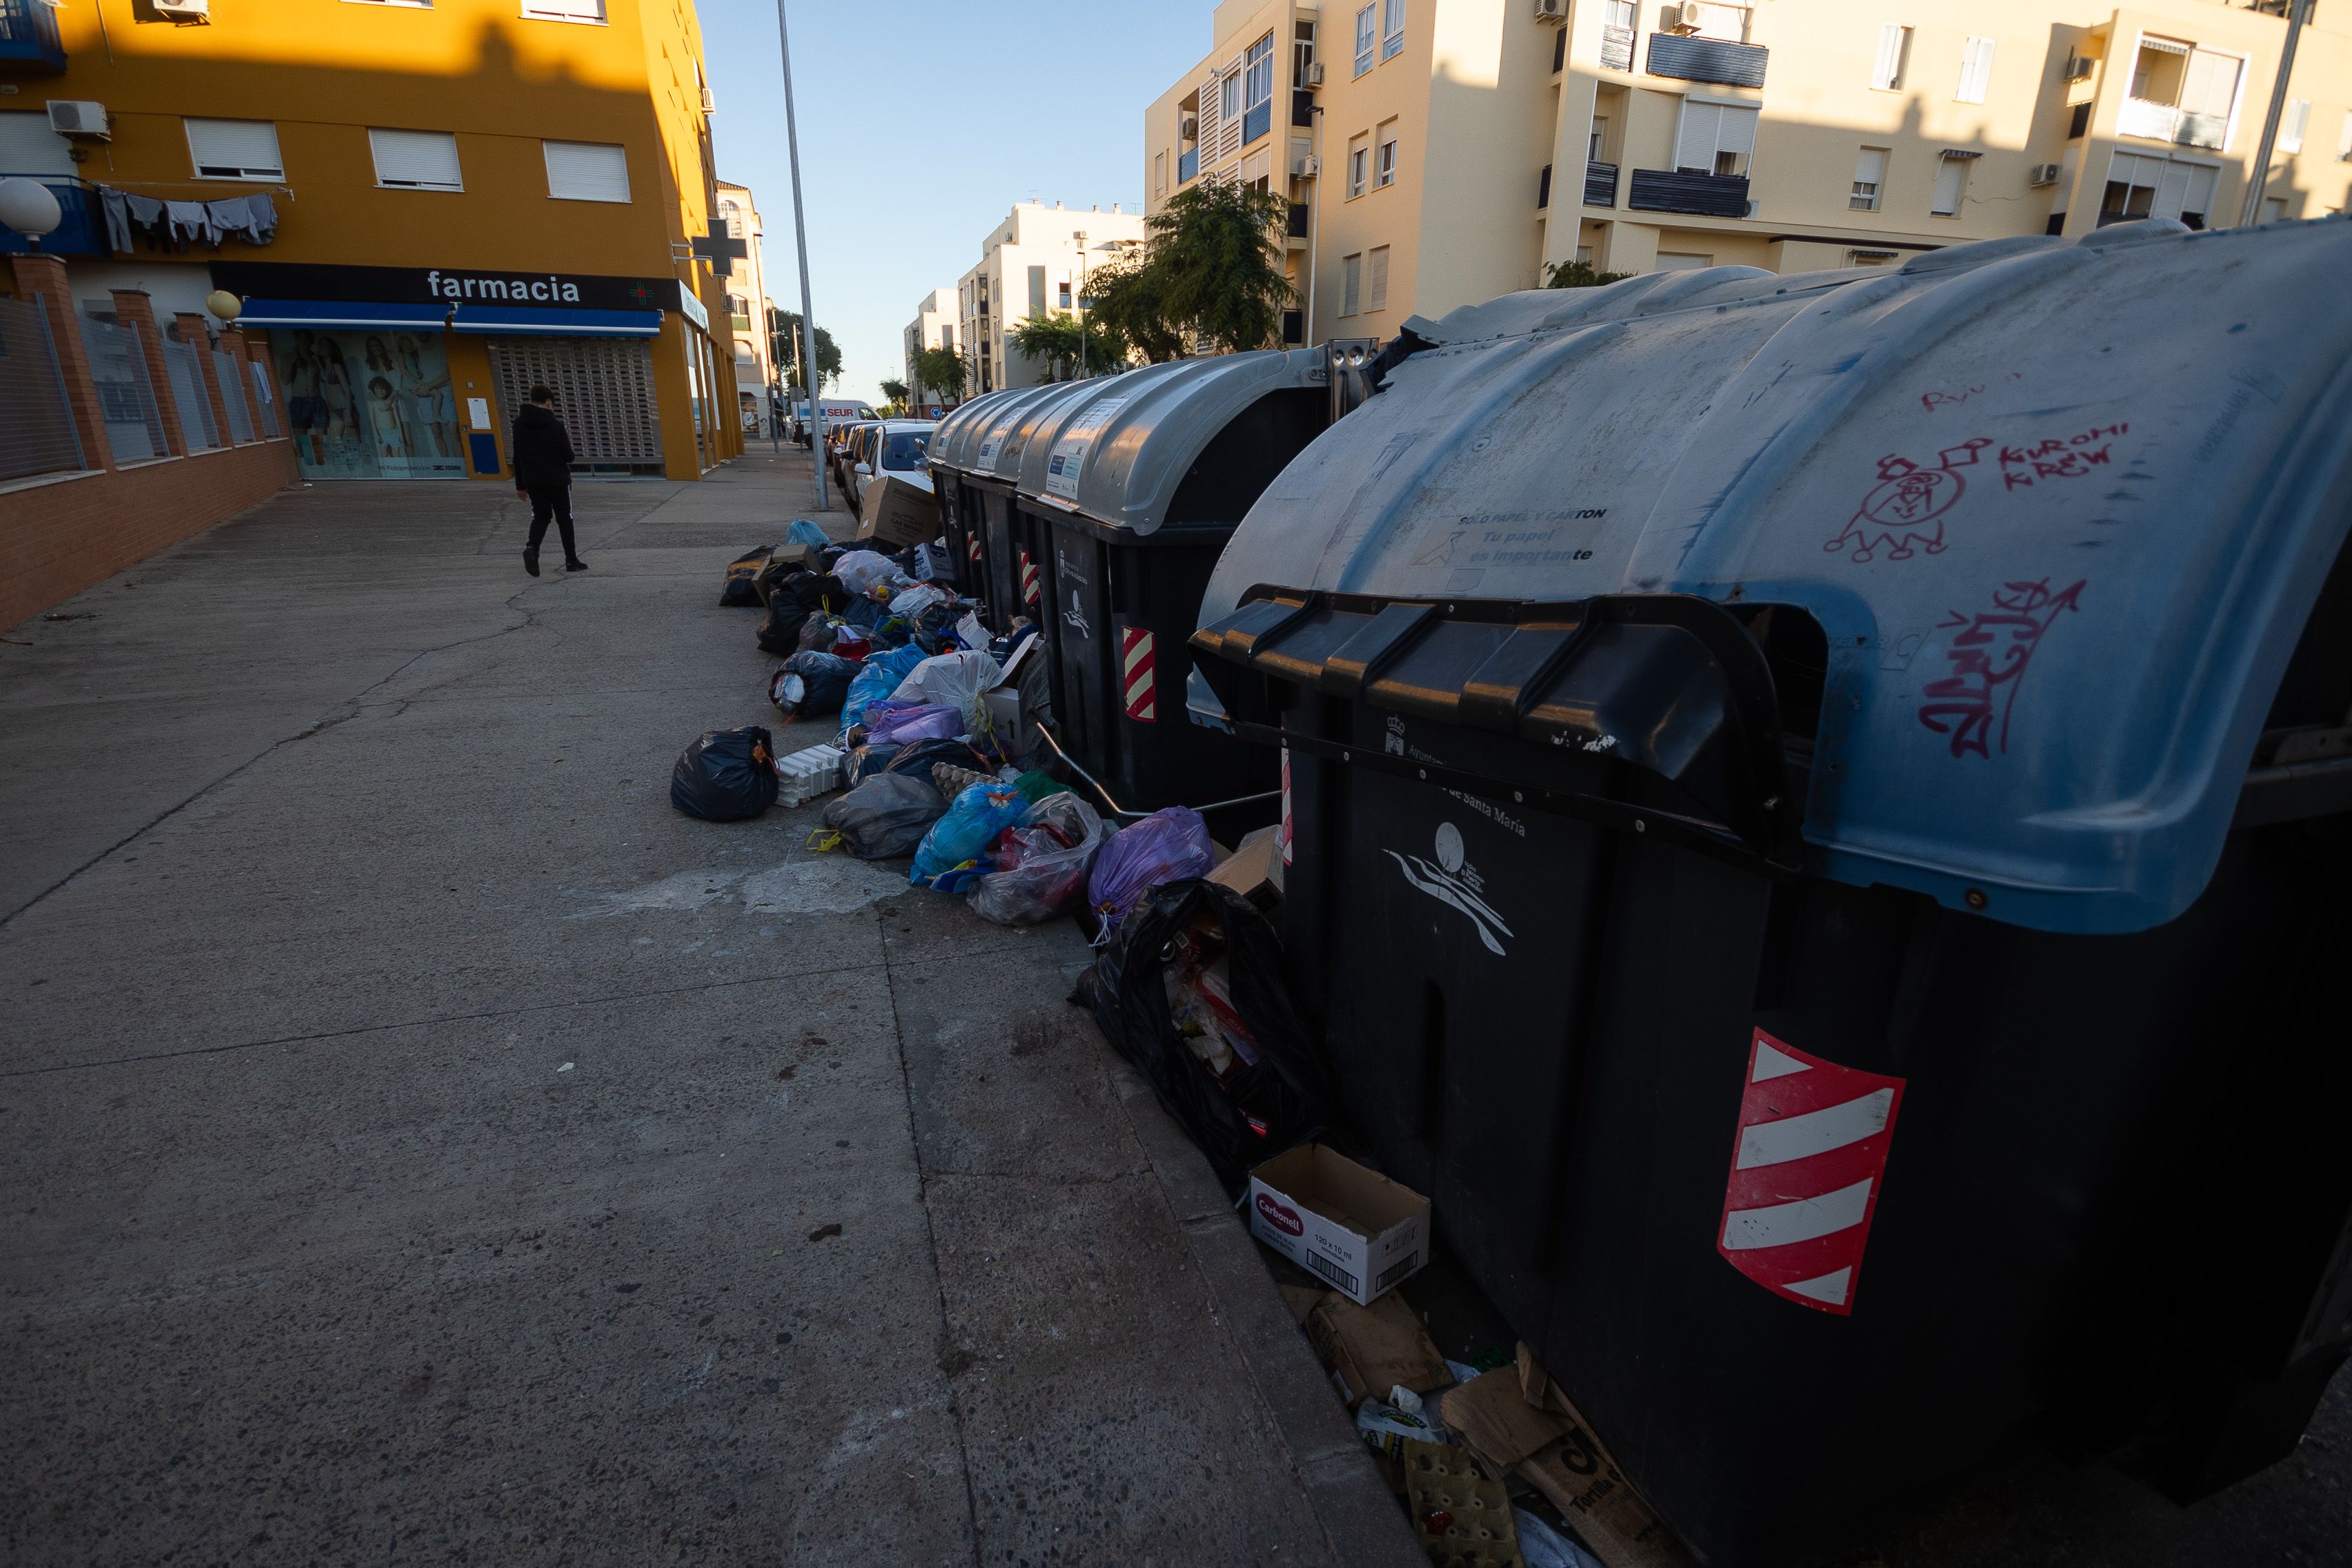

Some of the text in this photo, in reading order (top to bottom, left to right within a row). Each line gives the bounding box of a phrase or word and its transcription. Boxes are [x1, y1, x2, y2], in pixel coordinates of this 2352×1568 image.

[428, 271, 580, 302] farmacia
[827, 408, 854, 417] SEUR
[1999, 422, 2129, 471] KUROMI
[2003, 442, 2113, 491] KREW
[1458, 516, 1489, 525] SOLO
[1490, 513, 1528, 523] PAPEL
[1482, 529, 1556, 544] Tu papel
[1463, 793, 1491, 817] Santa
[1494, 807, 1526, 838] María
[1259, 1199, 1300, 1232] Carbonell
[1315, 1234, 1327, 1245] 120
[1334, 1244, 1342, 1255] 10
[1344, 1251, 1352, 1261] ml
[1569, 1479, 1616, 1514] Tortilla
